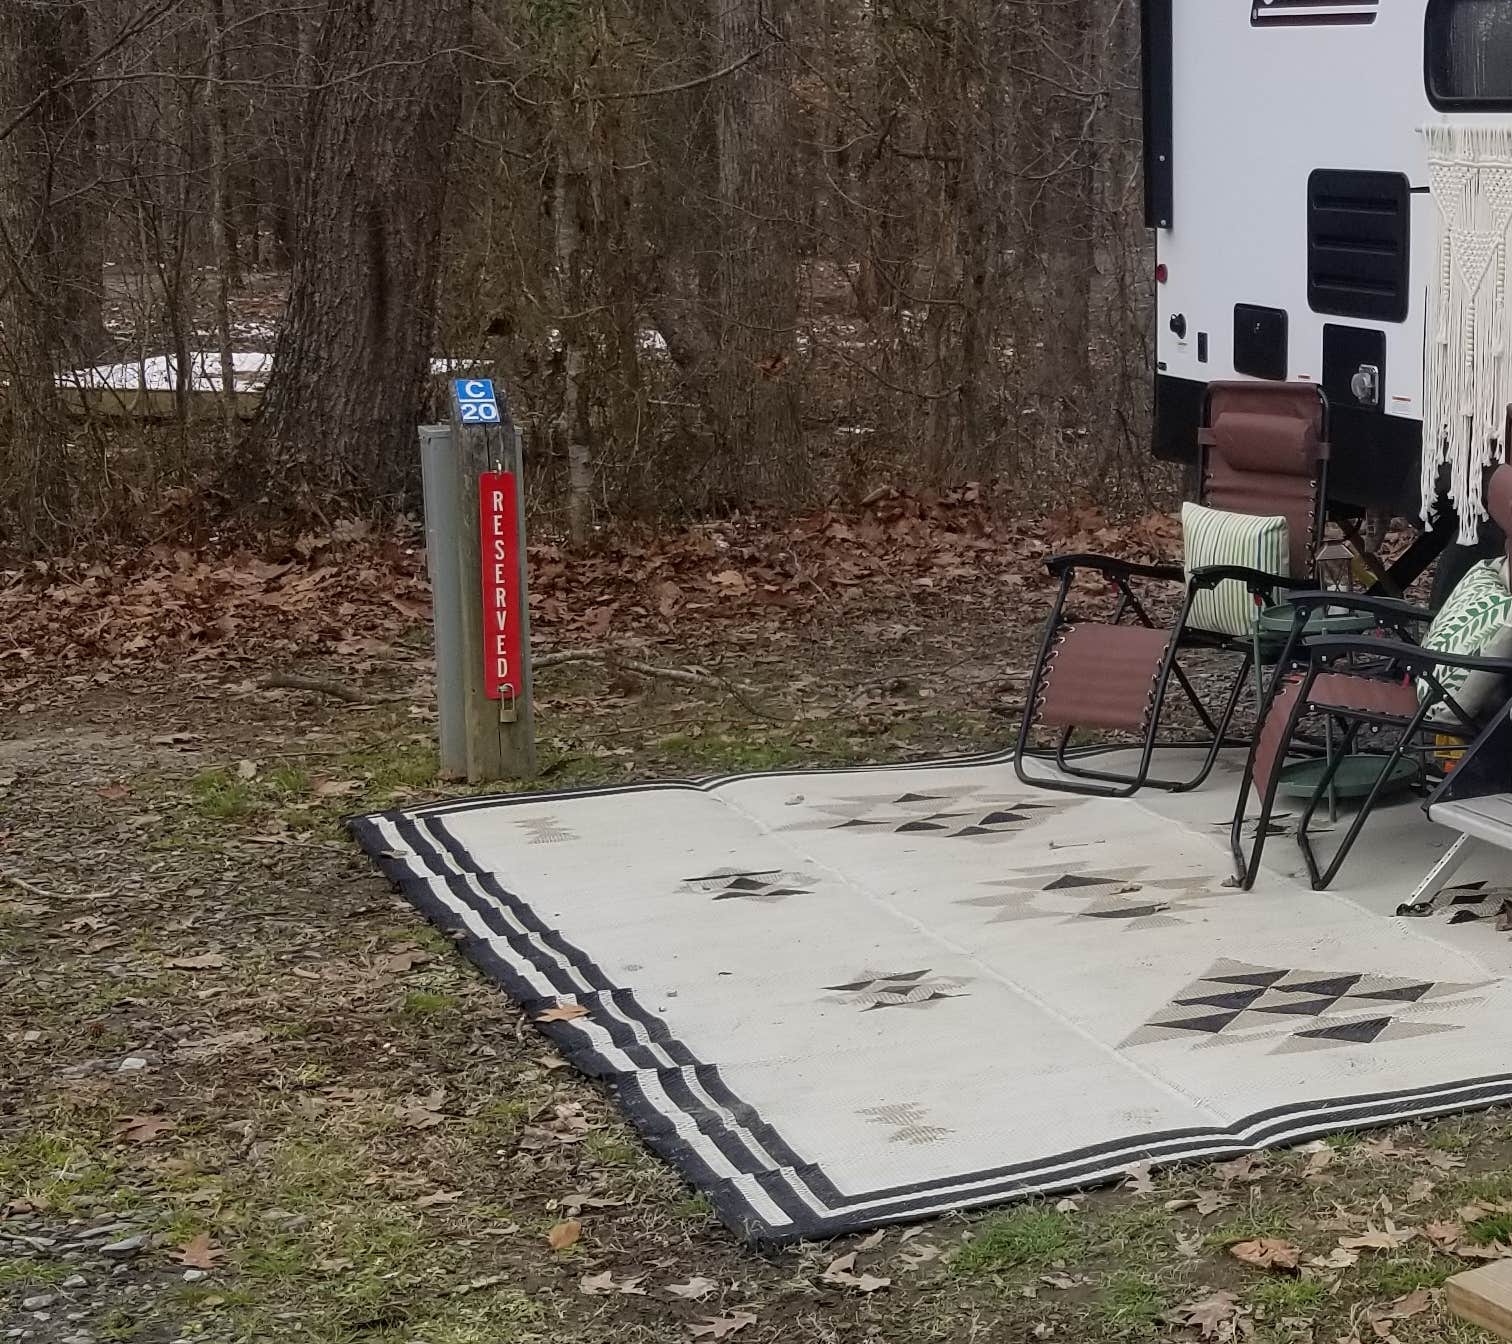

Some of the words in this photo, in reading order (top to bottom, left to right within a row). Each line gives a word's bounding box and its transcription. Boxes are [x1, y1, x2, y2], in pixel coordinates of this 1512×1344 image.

[465, 381, 486, 398] C
[460, 403, 497, 421] 20
[493, 490, 508, 678] RESERVED
